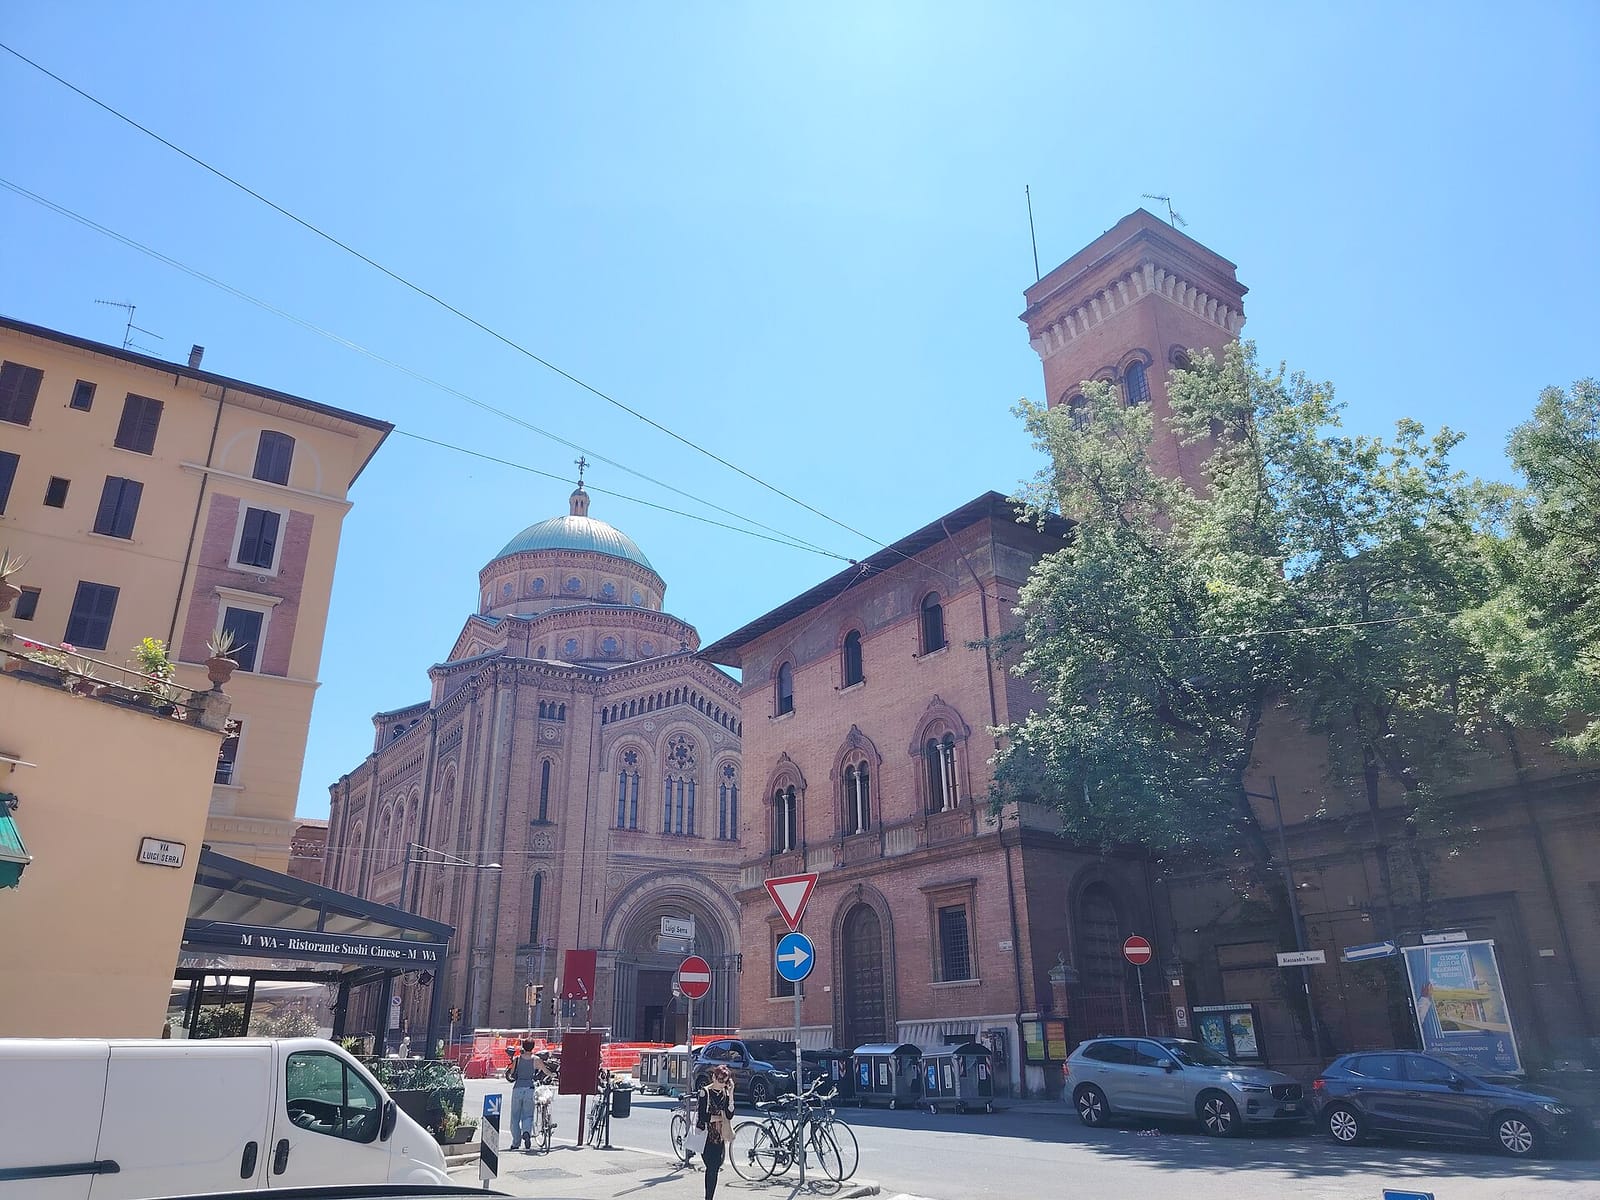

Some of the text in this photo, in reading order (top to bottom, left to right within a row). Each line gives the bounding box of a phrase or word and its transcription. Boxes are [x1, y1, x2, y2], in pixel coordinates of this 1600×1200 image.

[160, 843, 169, 851] VIA
[143, 852, 179, 863] LUIGI SERRA
[288, 938, 340, 953] Ristorante
[341, 943, 368, 956] Sushi
[370, 946, 401, 958] Cinese
